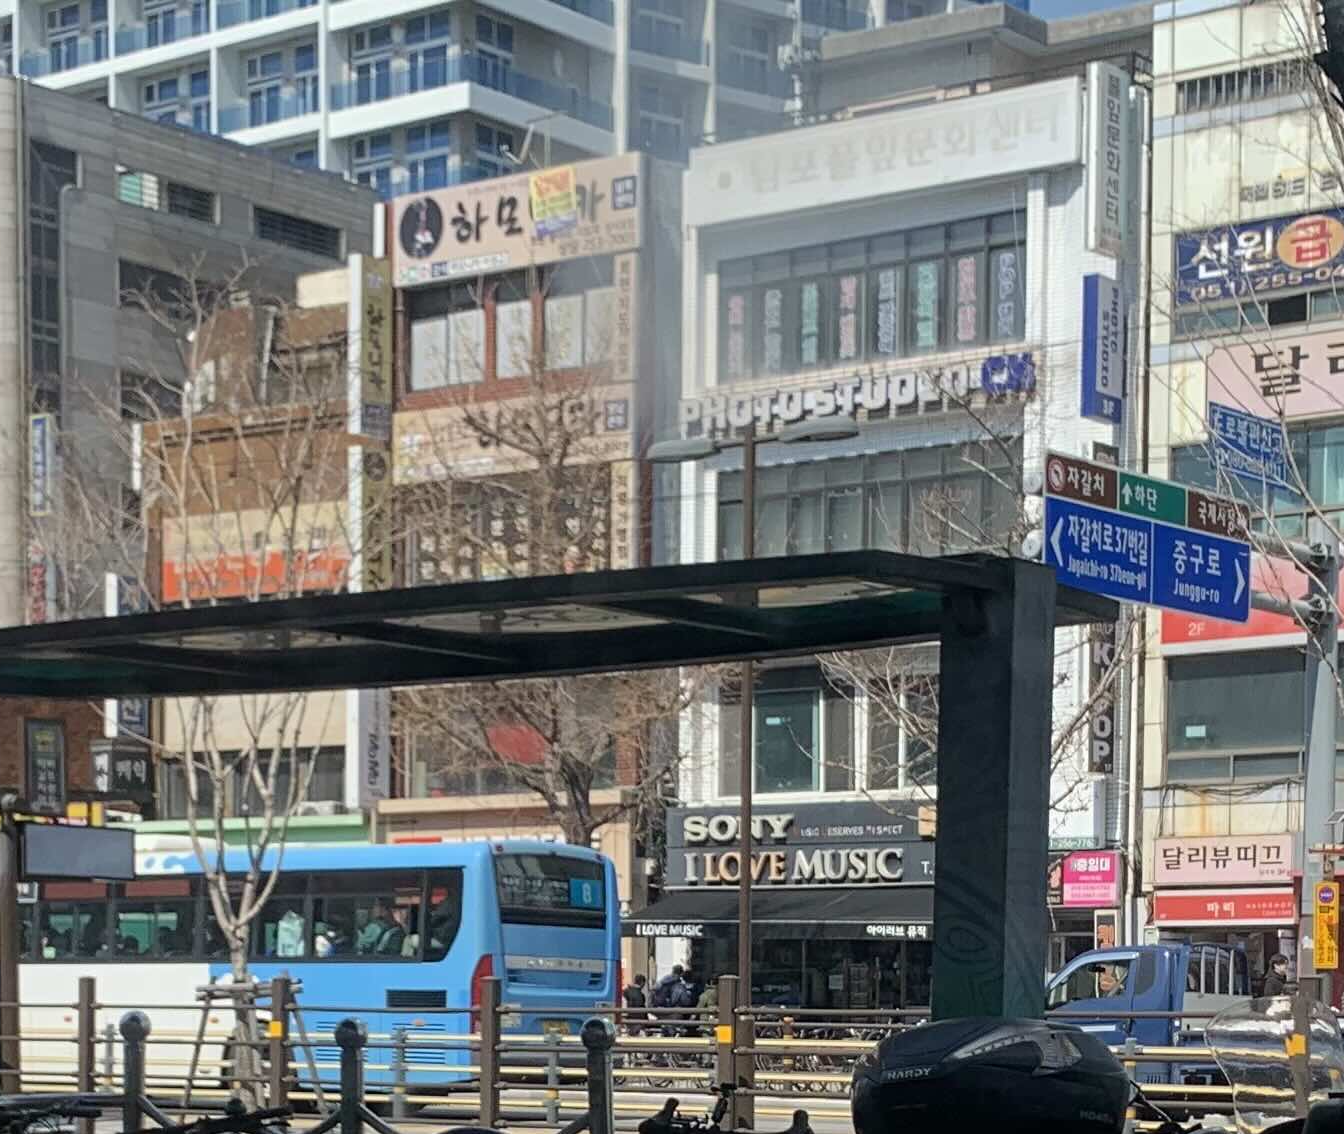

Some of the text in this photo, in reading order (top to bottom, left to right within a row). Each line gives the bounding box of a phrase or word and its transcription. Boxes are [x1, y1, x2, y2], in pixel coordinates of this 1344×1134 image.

[1067, 464, 1105, 496] 자갈치
[1134, 485, 1158, 512] 하단
[1067, 515, 1148, 568] 자갈치로37번길
[1172, 540, 1222, 577] 중구로
[1173, 578, 1220, 604] Junggu-ro
[1188, 620, 1206, 637] 2F
[683, 813, 794, 842] SONY
[684, 852, 698, 883] I
[703, 850, 786, 882] LOVE
[791, 848, 904, 881] MUSIC
[1162, 844, 1284, 871] 달리뷰띠끄
[642, 924, 668, 937] LOVE
[669, 924, 703, 937] MUSIC
[866, 924, 926, 938] 아이러브 뮤직
[887, 1066, 932, 1081] HARDY
